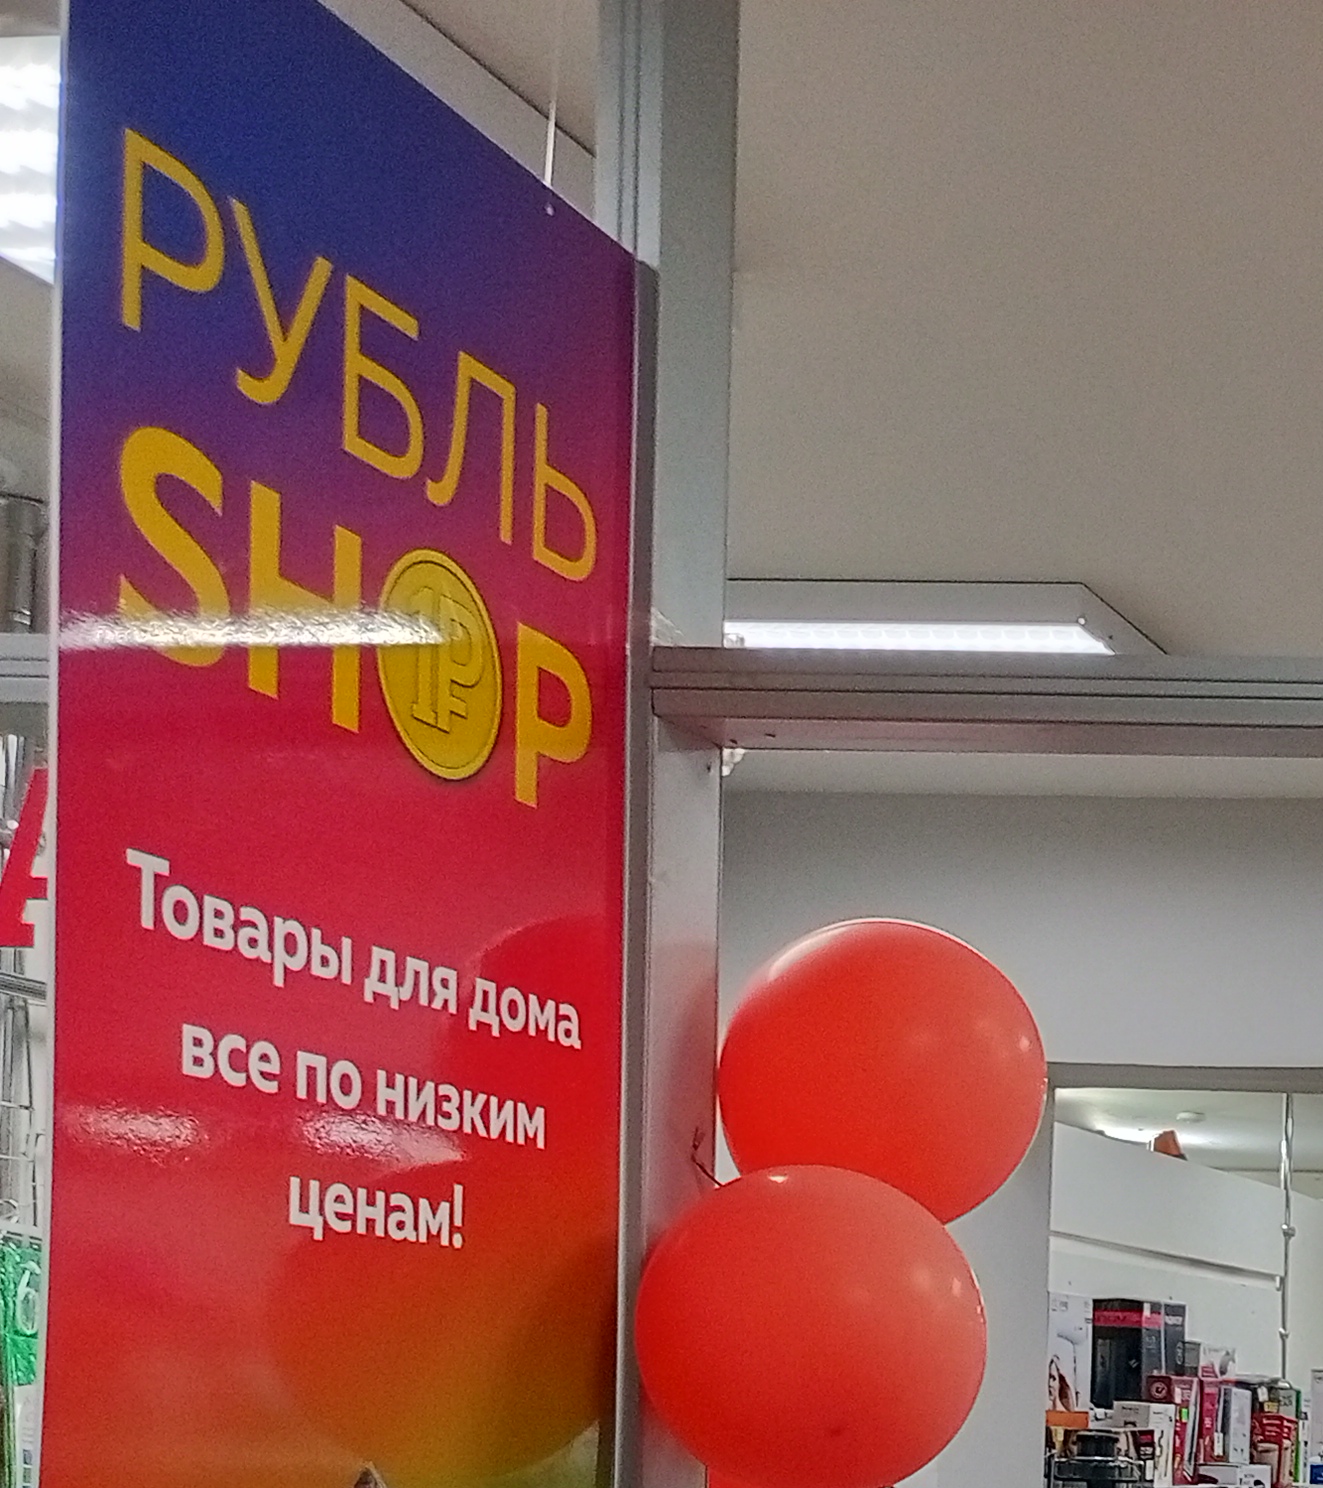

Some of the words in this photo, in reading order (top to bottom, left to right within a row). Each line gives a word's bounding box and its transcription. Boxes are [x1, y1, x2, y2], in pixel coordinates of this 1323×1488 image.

[119, 128, 597, 582] РУБЛЬ
[126, 848, 352, 987] Товары
[364, 946, 458, 1014] для
[468, 979, 582, 1049] дома
[181, 1024, 281, 1094] все
[295, 1051, 362, 1111] по
[376, 1068, 546, 1150] низким
[288, 1175, 465, 1250] ценам!
